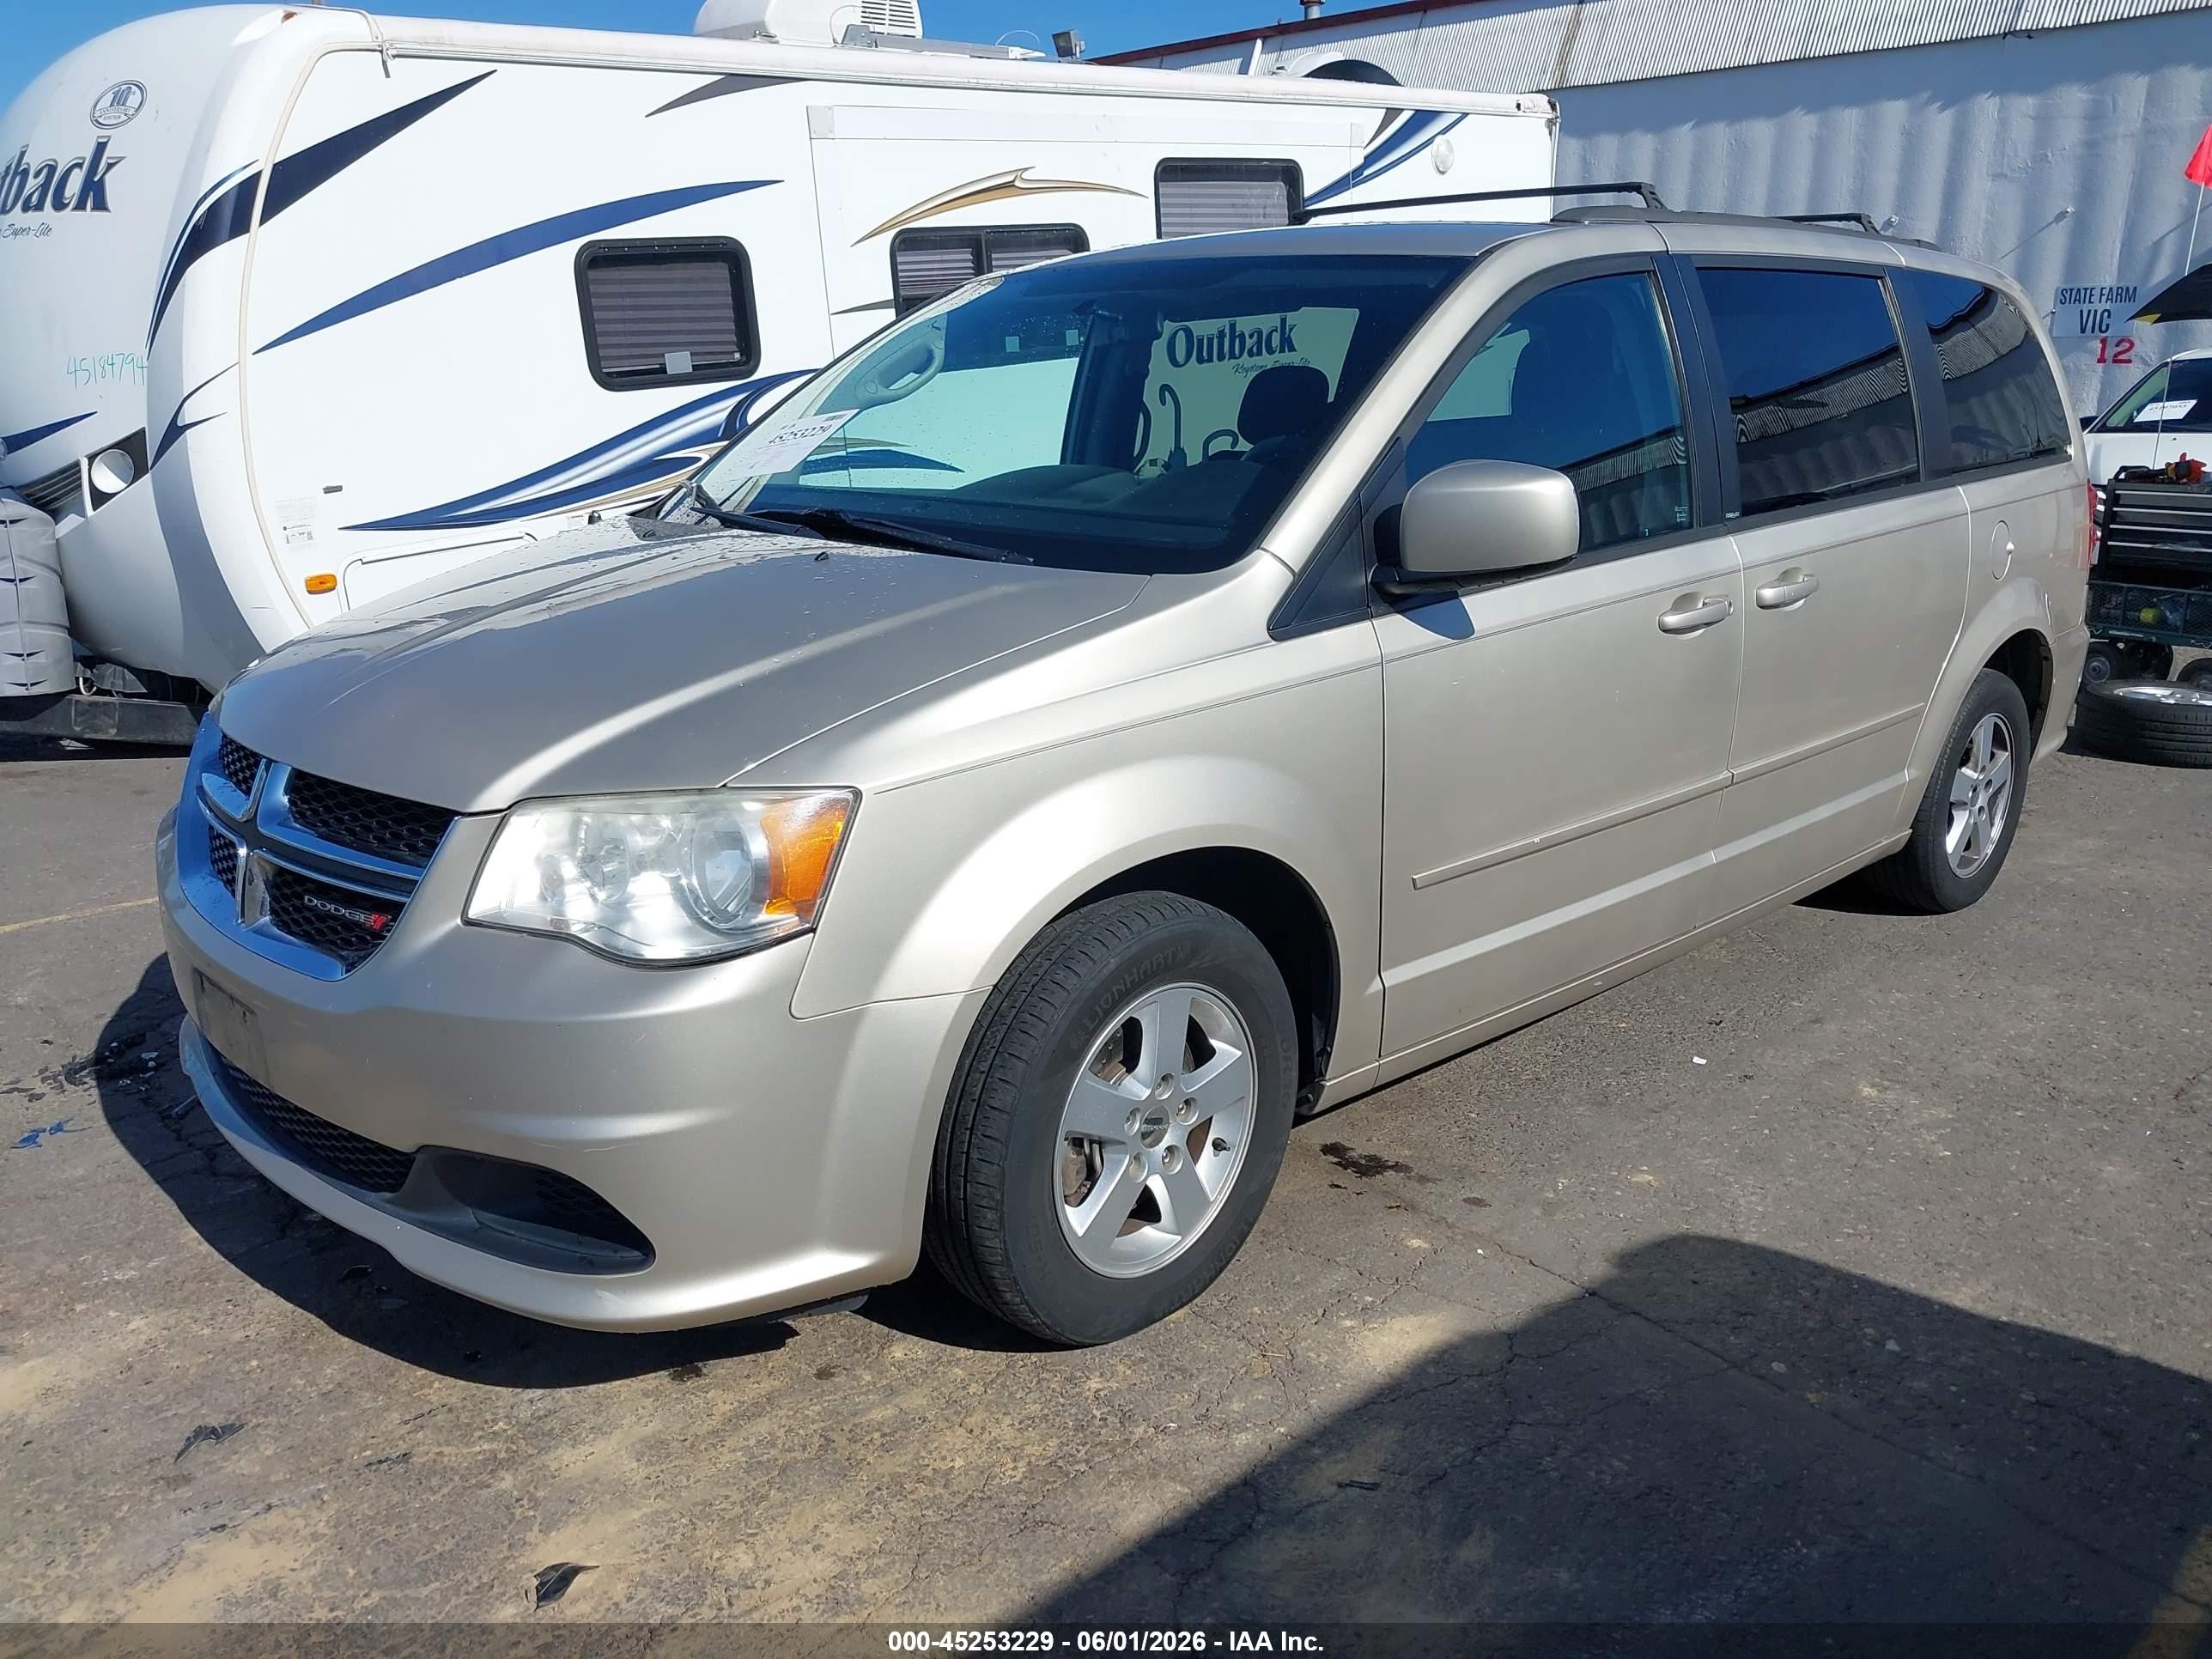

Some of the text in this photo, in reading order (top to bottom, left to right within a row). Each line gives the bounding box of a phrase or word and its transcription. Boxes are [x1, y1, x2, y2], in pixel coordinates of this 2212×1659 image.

[2059, 285, 2137, 305] STATE FARM
[2079, 308, 2112, 334] VIC
[1166, 313, 1299, 368] Outback
[2096, 337, 2135, 364] 12
[66, 352, 149, 390] 45184794
[304, 895, 374, 926] DODGE
